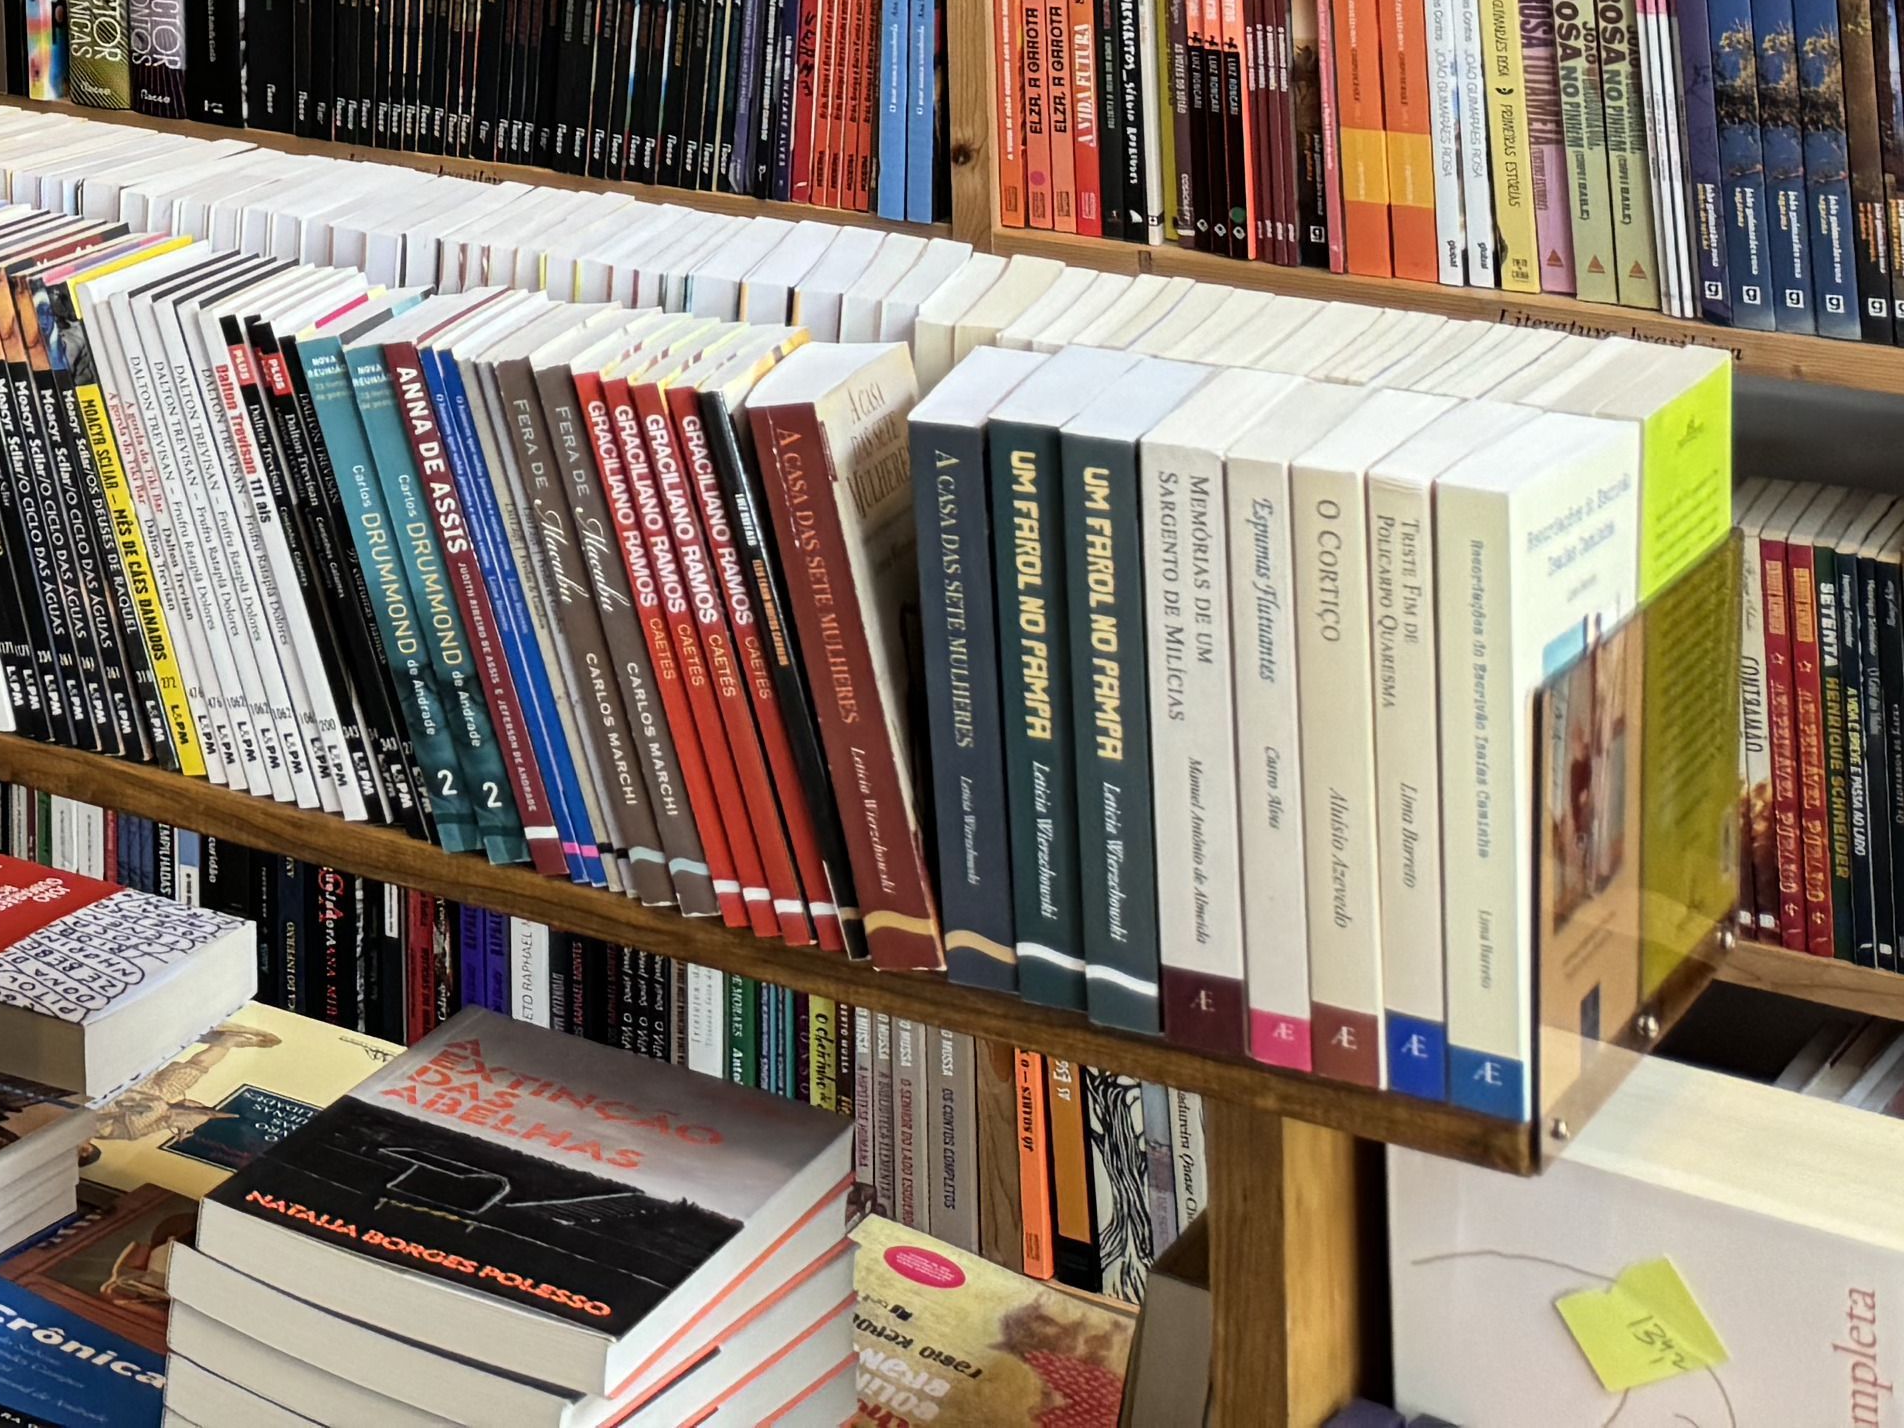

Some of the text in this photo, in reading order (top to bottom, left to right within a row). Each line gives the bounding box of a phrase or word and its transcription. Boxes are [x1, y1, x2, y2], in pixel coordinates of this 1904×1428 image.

[396, 366, 468, 554] ANNA DE ASSIS
[646, 415, 718, 623] GRACILIANO RAMOS
[352, 465, 435, 736] Carlos DRUMMOND Andrade
[513, 399, 637, 806] FERA DE CARLOS MARCHI
[1009, 450, 1053, 741] UM FAROL NO PAMPA
[1159, 471, 1185, 722] SARGENTO MILÍCIAS
[1189, 474, 1213, 599] MEMÓRIAS
[1316, 498, 1341, 643] O CORTIÇO
[437, 769, 457, 796] 2
[1820, 582, 1851, 880] SETENTA HENRIQUE SCHNEIDER
[1329, 787, 1349, 930] Aluísio Azevedo
[1402, 830, 1416, 889] Barreto
[379, 1085, 645, 1171] ABELHAS
[407, 1066, 515, 1110] DAS
[424, 1048, 725, 1147] EXTINÇÃO
[244, 1189, 613, 1319] NATALIA BORGES POLESSO
